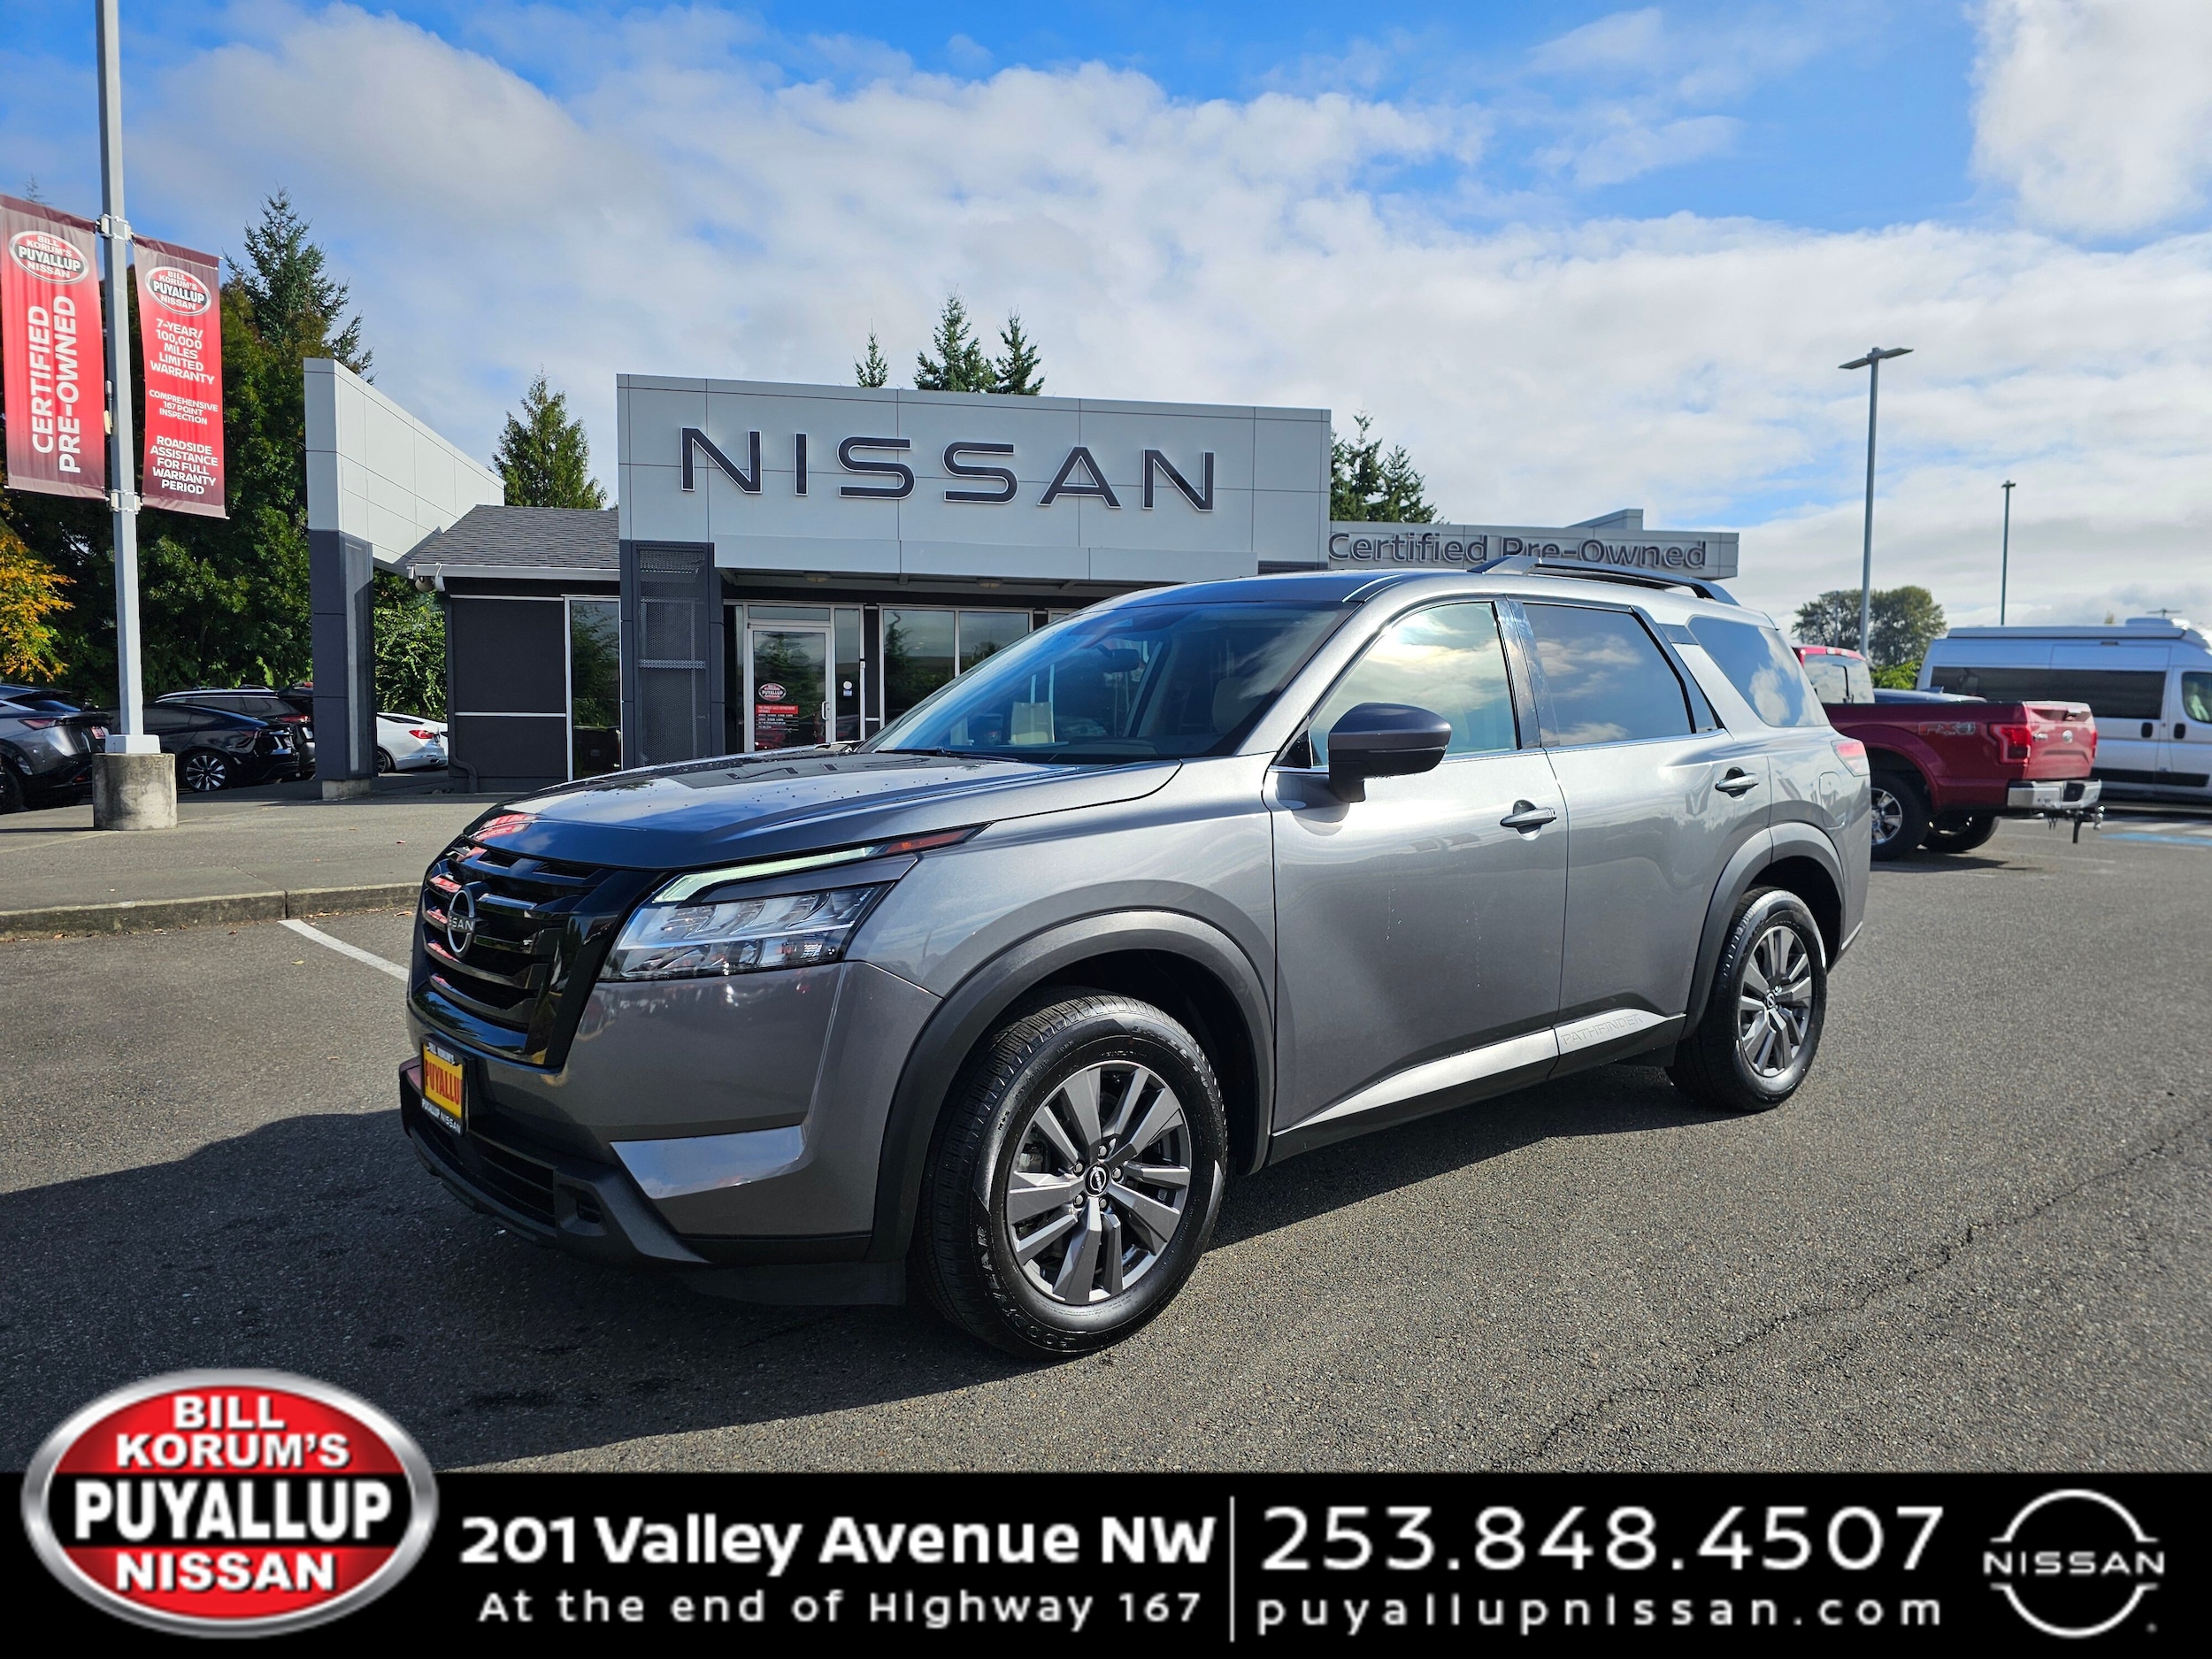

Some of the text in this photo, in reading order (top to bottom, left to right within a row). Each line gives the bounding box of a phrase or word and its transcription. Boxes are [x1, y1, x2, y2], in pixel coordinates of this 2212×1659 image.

[26, 239, 73, 257] KORUM'S
[37, 235, 59, 247] BILL
[18, 245, 81, 272] PUYALLUP
[27, 261, 71, 279] NISSAN
[167, 271, 187, 281] BILL
[153, 280, 204, 303] PUYALLUP
[158, 274, 197, 290] KORUM'S
[160, 295, 196, 311] NISSAN
[156, 318, 204, 340] 7-YEAR/
[156, 329, 203, 350] 100,000
[164, 342, 198, 360] MILES
[150, 360, 215, 385] WARRANTY
[159, 352, 204, 372] LIMITED
[28, 305, 53, 454] CERTIFIED
[54, 296, 81, 474] PRE-OWNED
[149, 389, 219, 411] COMPREHENSIVE
[163, 401, 204, 416] 167 POINT
[159, 408, 208, 425] INSPECTION
[150, 445, 219, 466] ASSISTANCE
[157, 435, 212, 455] ROADSIDE
[152, 466, 217, 487] WARRANTY
[157, 457, 210, 475] FOR FULL
[680, 426, 1216, 512] NISSAN
[161, 480, 205, 495] PERIOD
[1328, 532, 1707, 568] Certified Pre-Owned
[1560, 1013, 1644, 1046] PATHFINDER
[425, 1058, 461, 1106] PUYALLU
